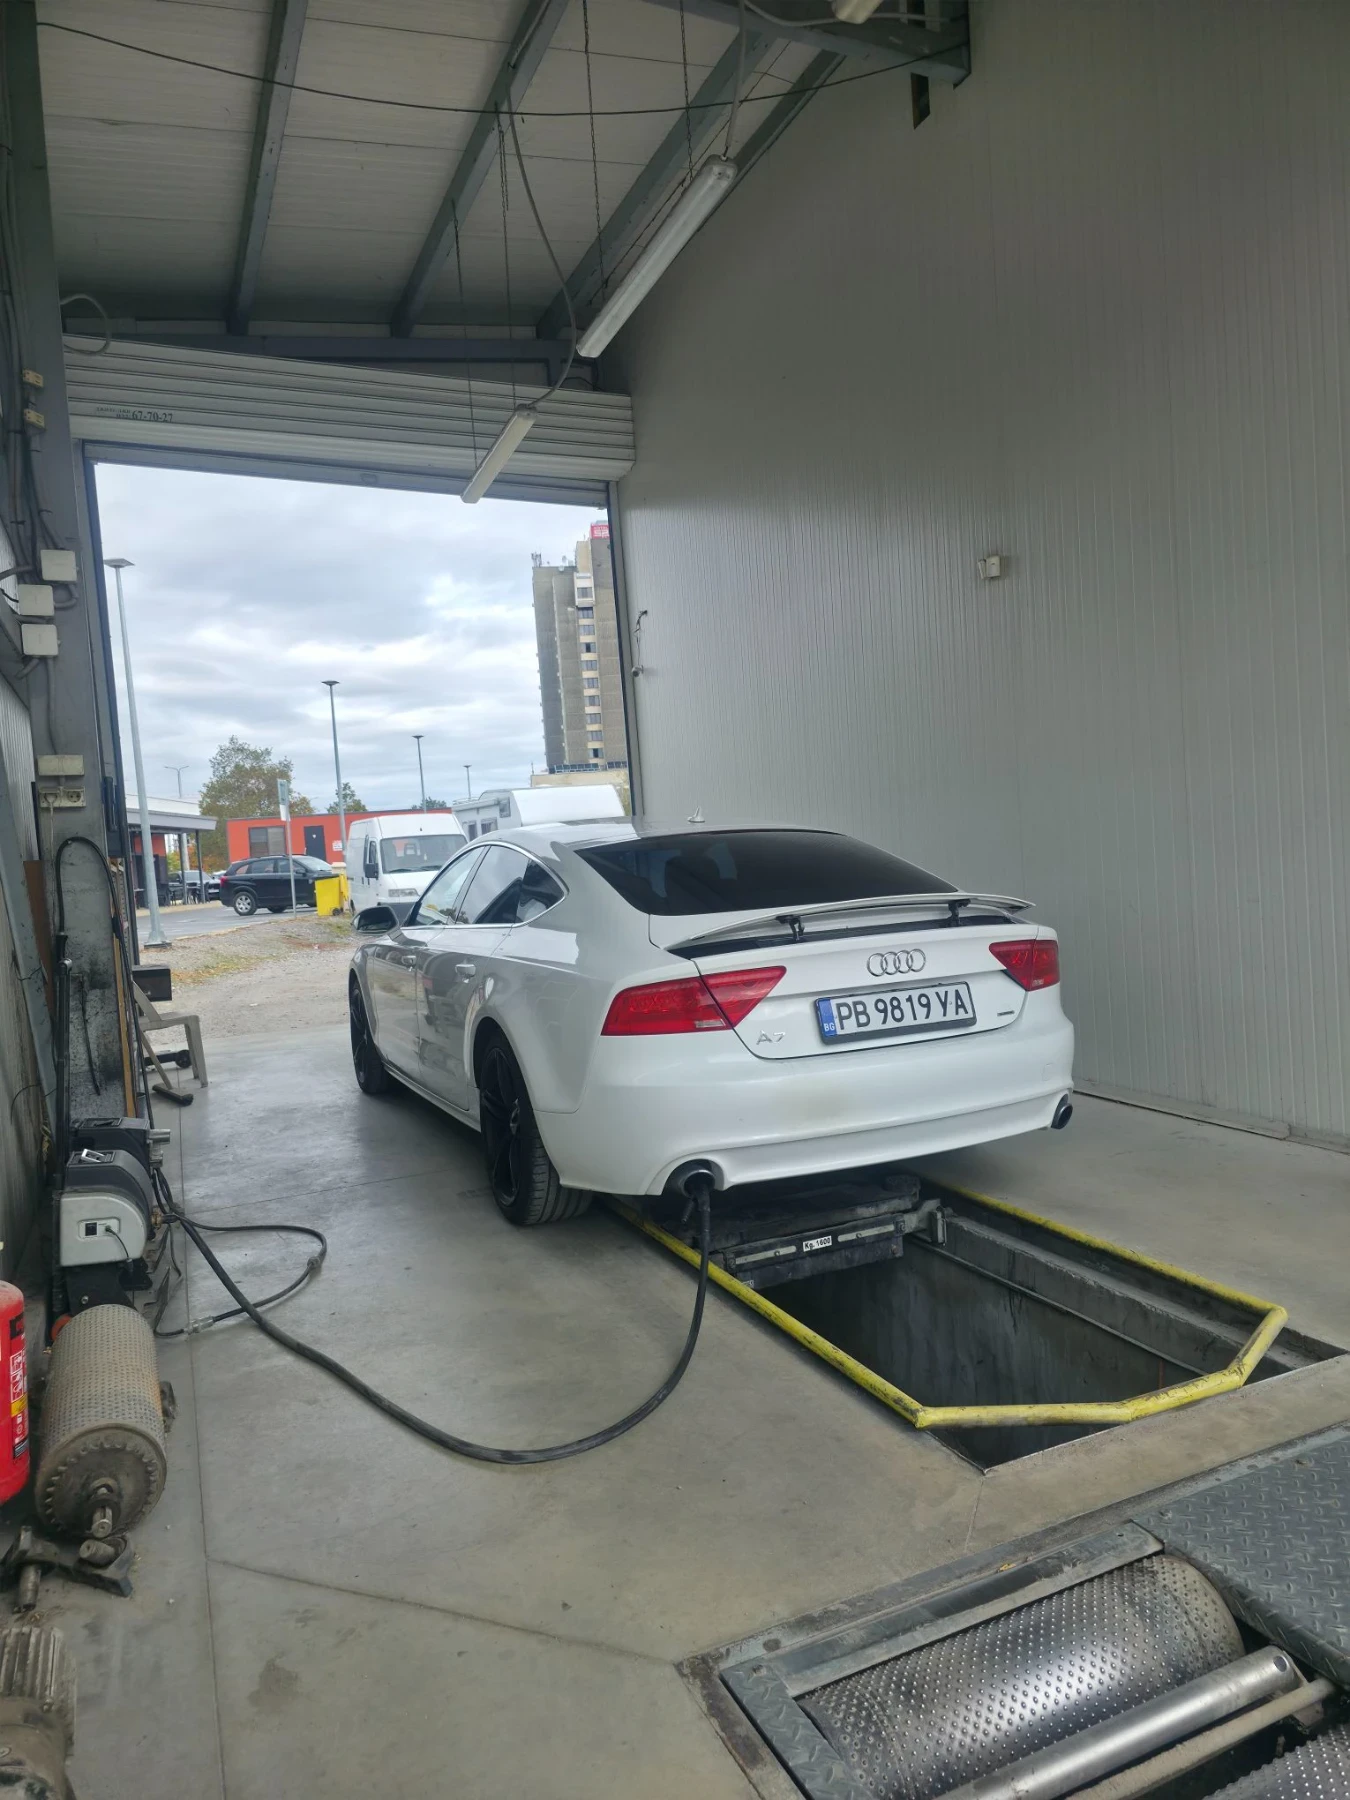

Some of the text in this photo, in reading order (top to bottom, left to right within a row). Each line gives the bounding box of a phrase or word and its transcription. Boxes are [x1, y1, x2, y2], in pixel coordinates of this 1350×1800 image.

[132, 410, 173, 422] 67-70-27
[835, 989, 969, 1030] PB 9819 YA
[823, 1022, 835, 1032] BG
[756, 1030, 786, 1045] A7
